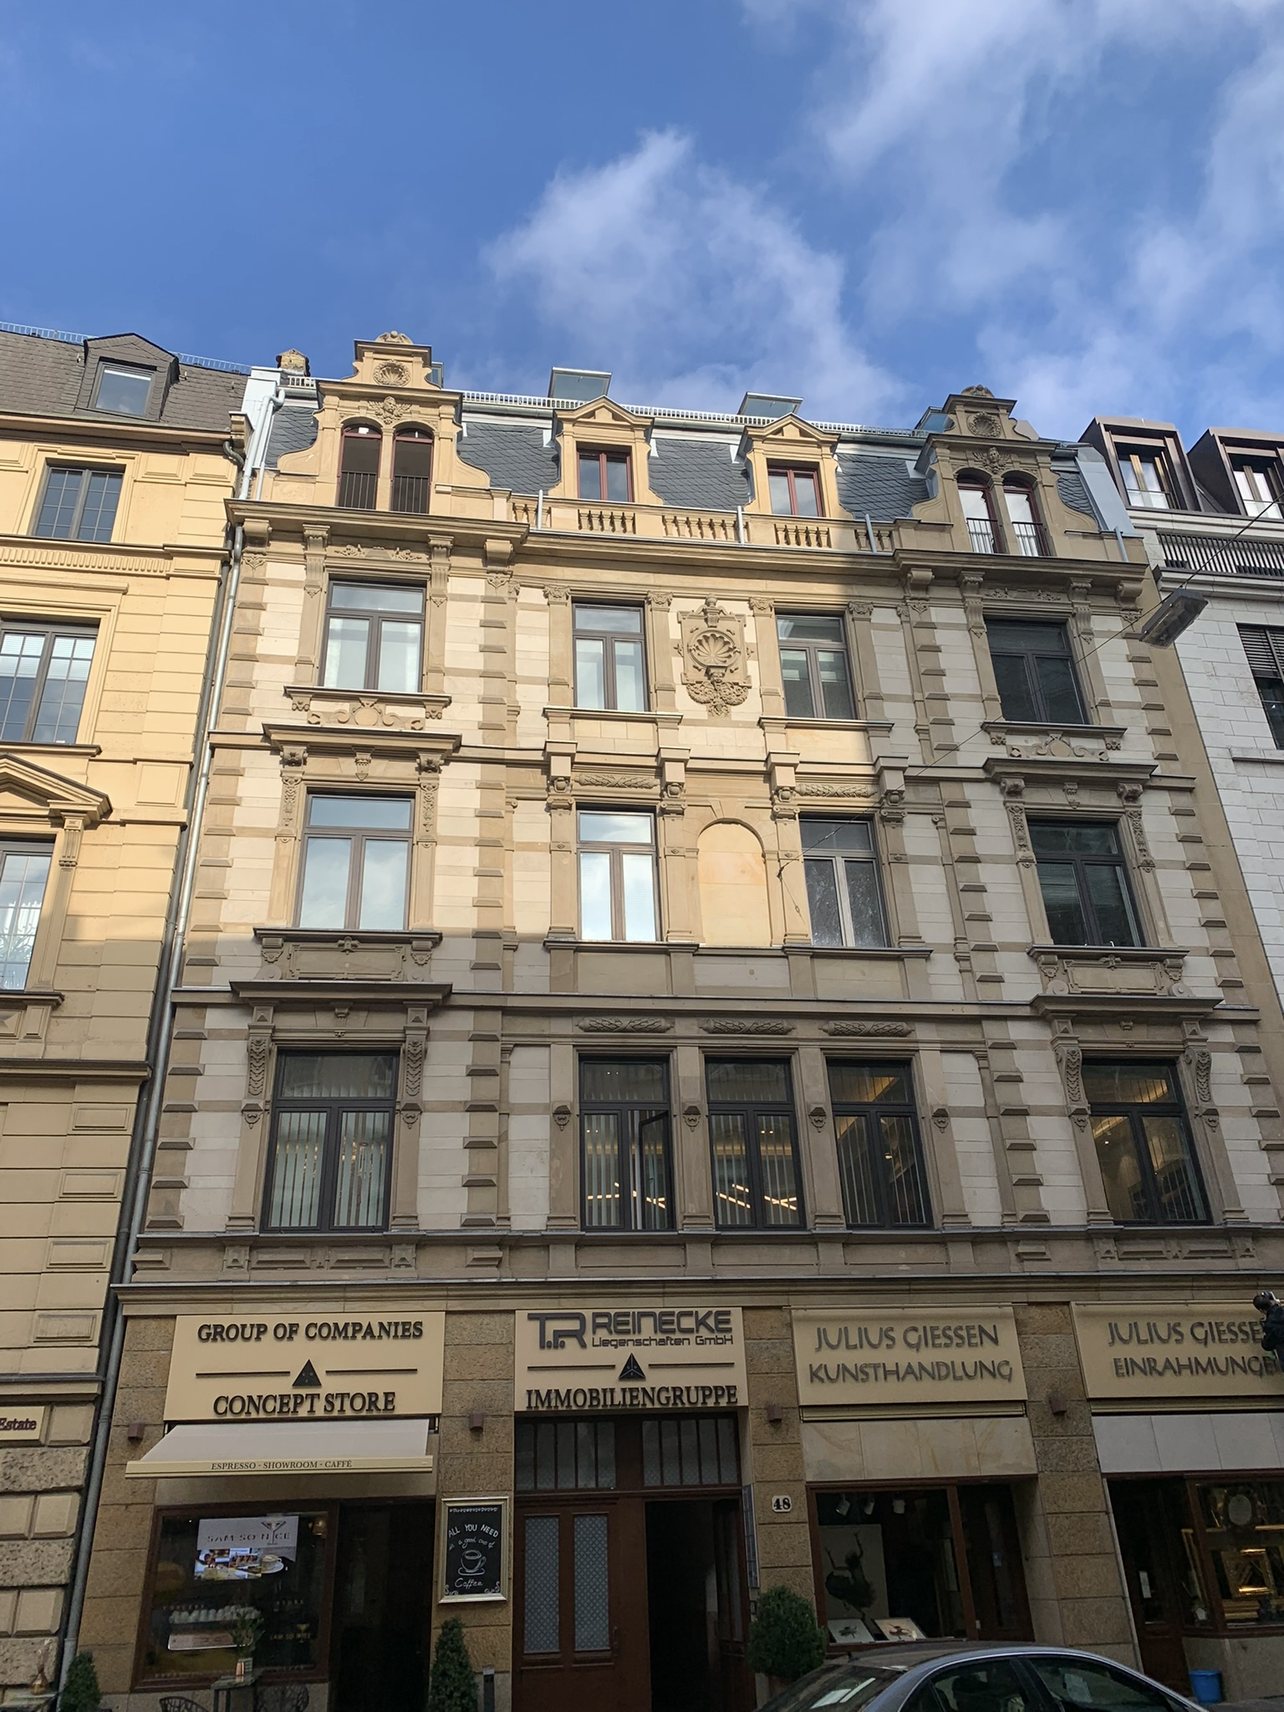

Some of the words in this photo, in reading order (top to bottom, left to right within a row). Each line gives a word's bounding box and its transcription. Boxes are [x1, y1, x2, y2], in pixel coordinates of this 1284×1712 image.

[198, 1323, 268, 1342] GROUP
[273, 1323, 300, 1341] OF
[305, 1321, 424, 1341] COMPANIES
[592, 1310, 733, 1335] REINECKE
[592, 1335, 690, 1349] Liegenschaften
[695, 1334, 734, 1346] GmbH
[815, 1325, 897, 1352] JULIUS
[902, 1323, 1000, 1353] GIESSEN
[1107, 1320, 1185, 1347] JULIUS
[1190, 1320, 1264, 1348] GIESSE
[808, 1359, 1013, 1384] KUNSTHANDLUNG
[1112, 1355, 1280, 1379] EINRAHMUNGE
[213, 1393, 320, 1416] CONCEPT
[323, 1391, 397, 1414] STORE
[526, 1385, 739, 1410] IMMOBILIENGRUPPE
[0, 1417, 37, 1431] Estate
[211, 1461, 256, 1470] ESPRESSO
[262, 1460, 318, 1470] SHOWROOM
[773, 1497, 791, 1510] 48
[448, 1527, 460, 1538] ALL
[465, 1524, 478, 1532] YOU
[481, 1524, 499, 1538] NEED
[454, 1578, 483, 1590] Coffee
